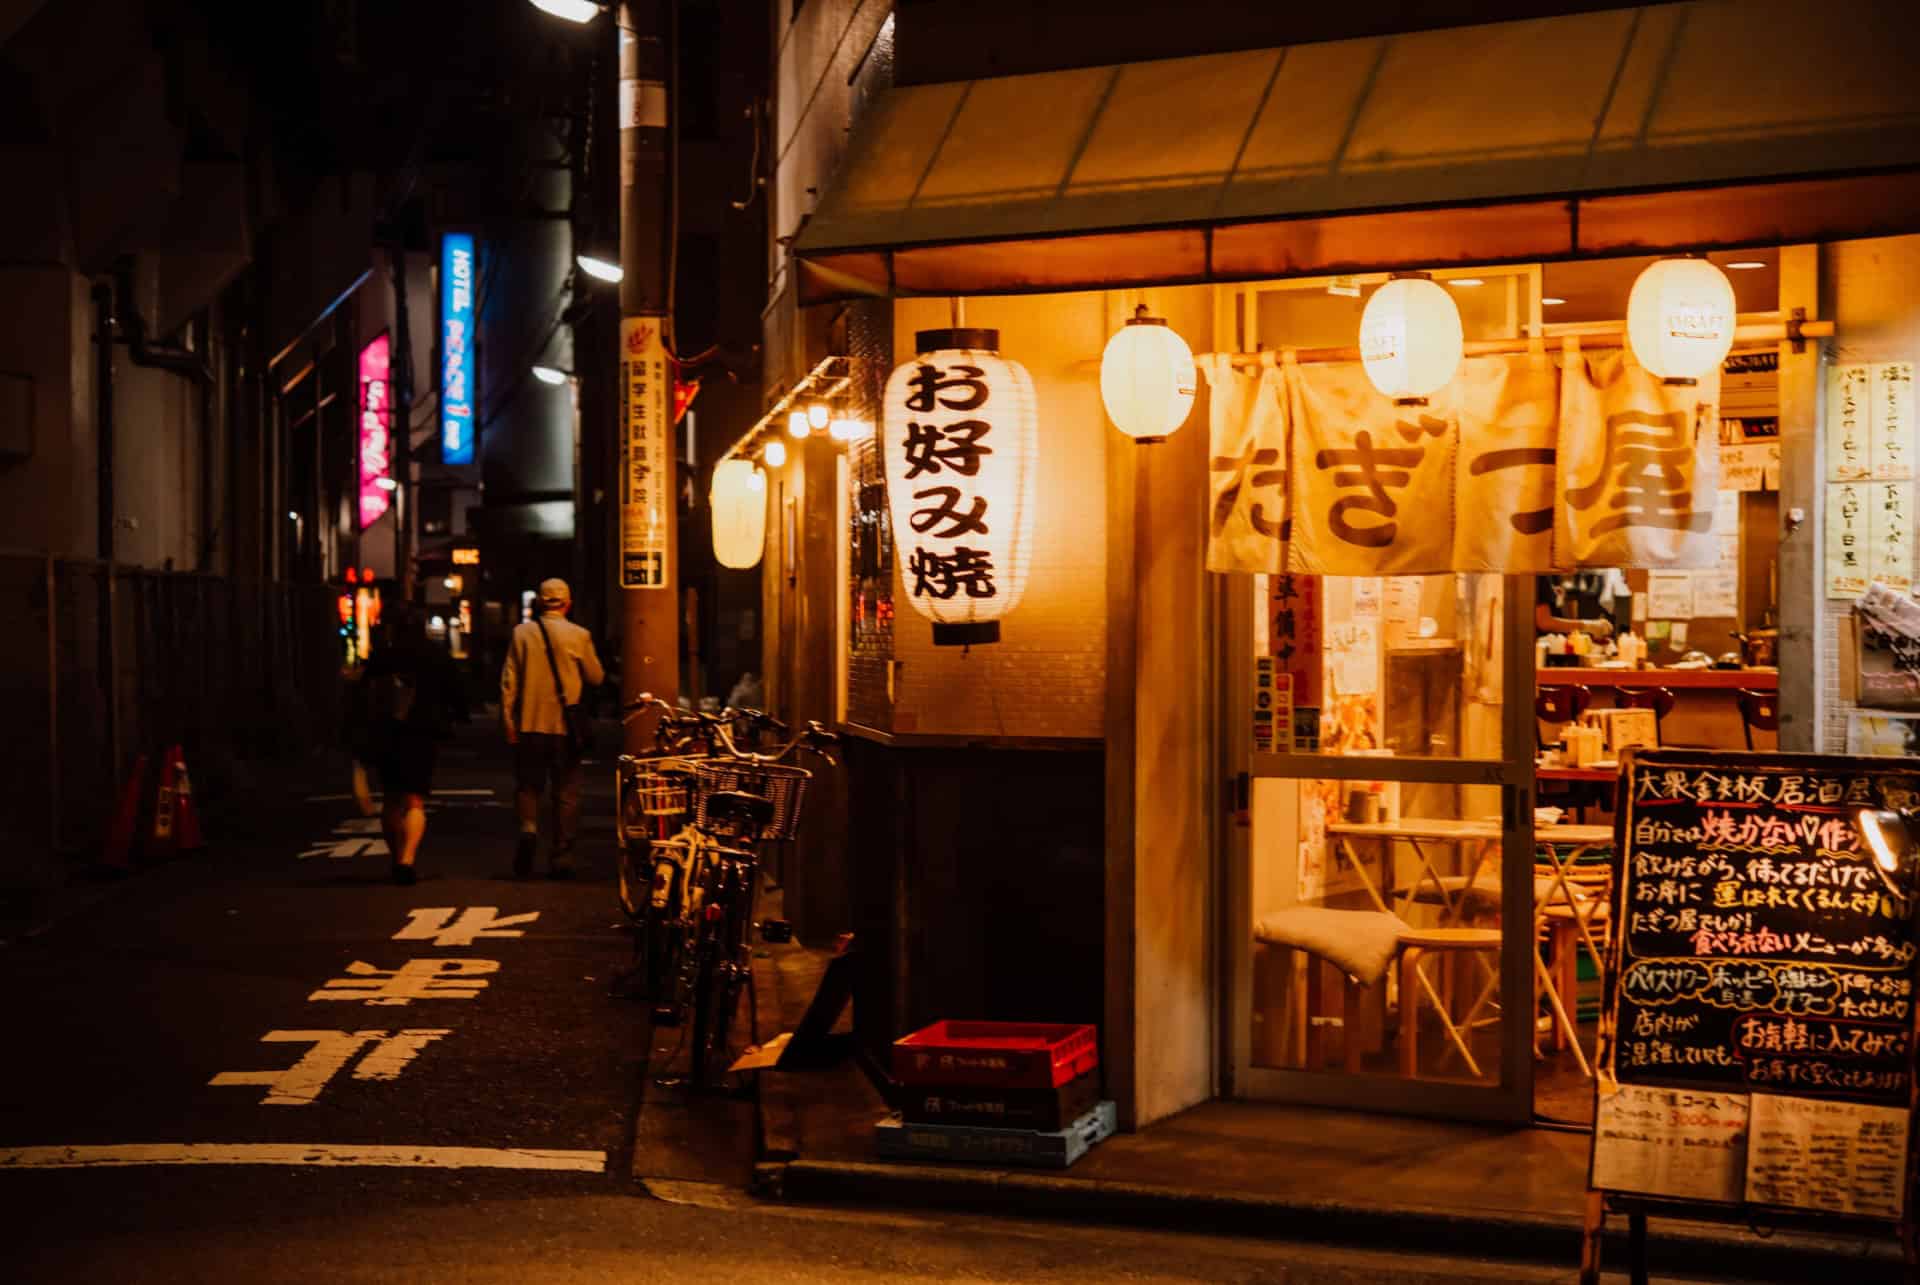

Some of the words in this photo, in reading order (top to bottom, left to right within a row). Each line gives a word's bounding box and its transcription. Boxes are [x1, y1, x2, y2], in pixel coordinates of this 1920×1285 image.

[902, 365, 999, 601] お好み焼
[1211, 410, 1715, 549] たぎつ屋
